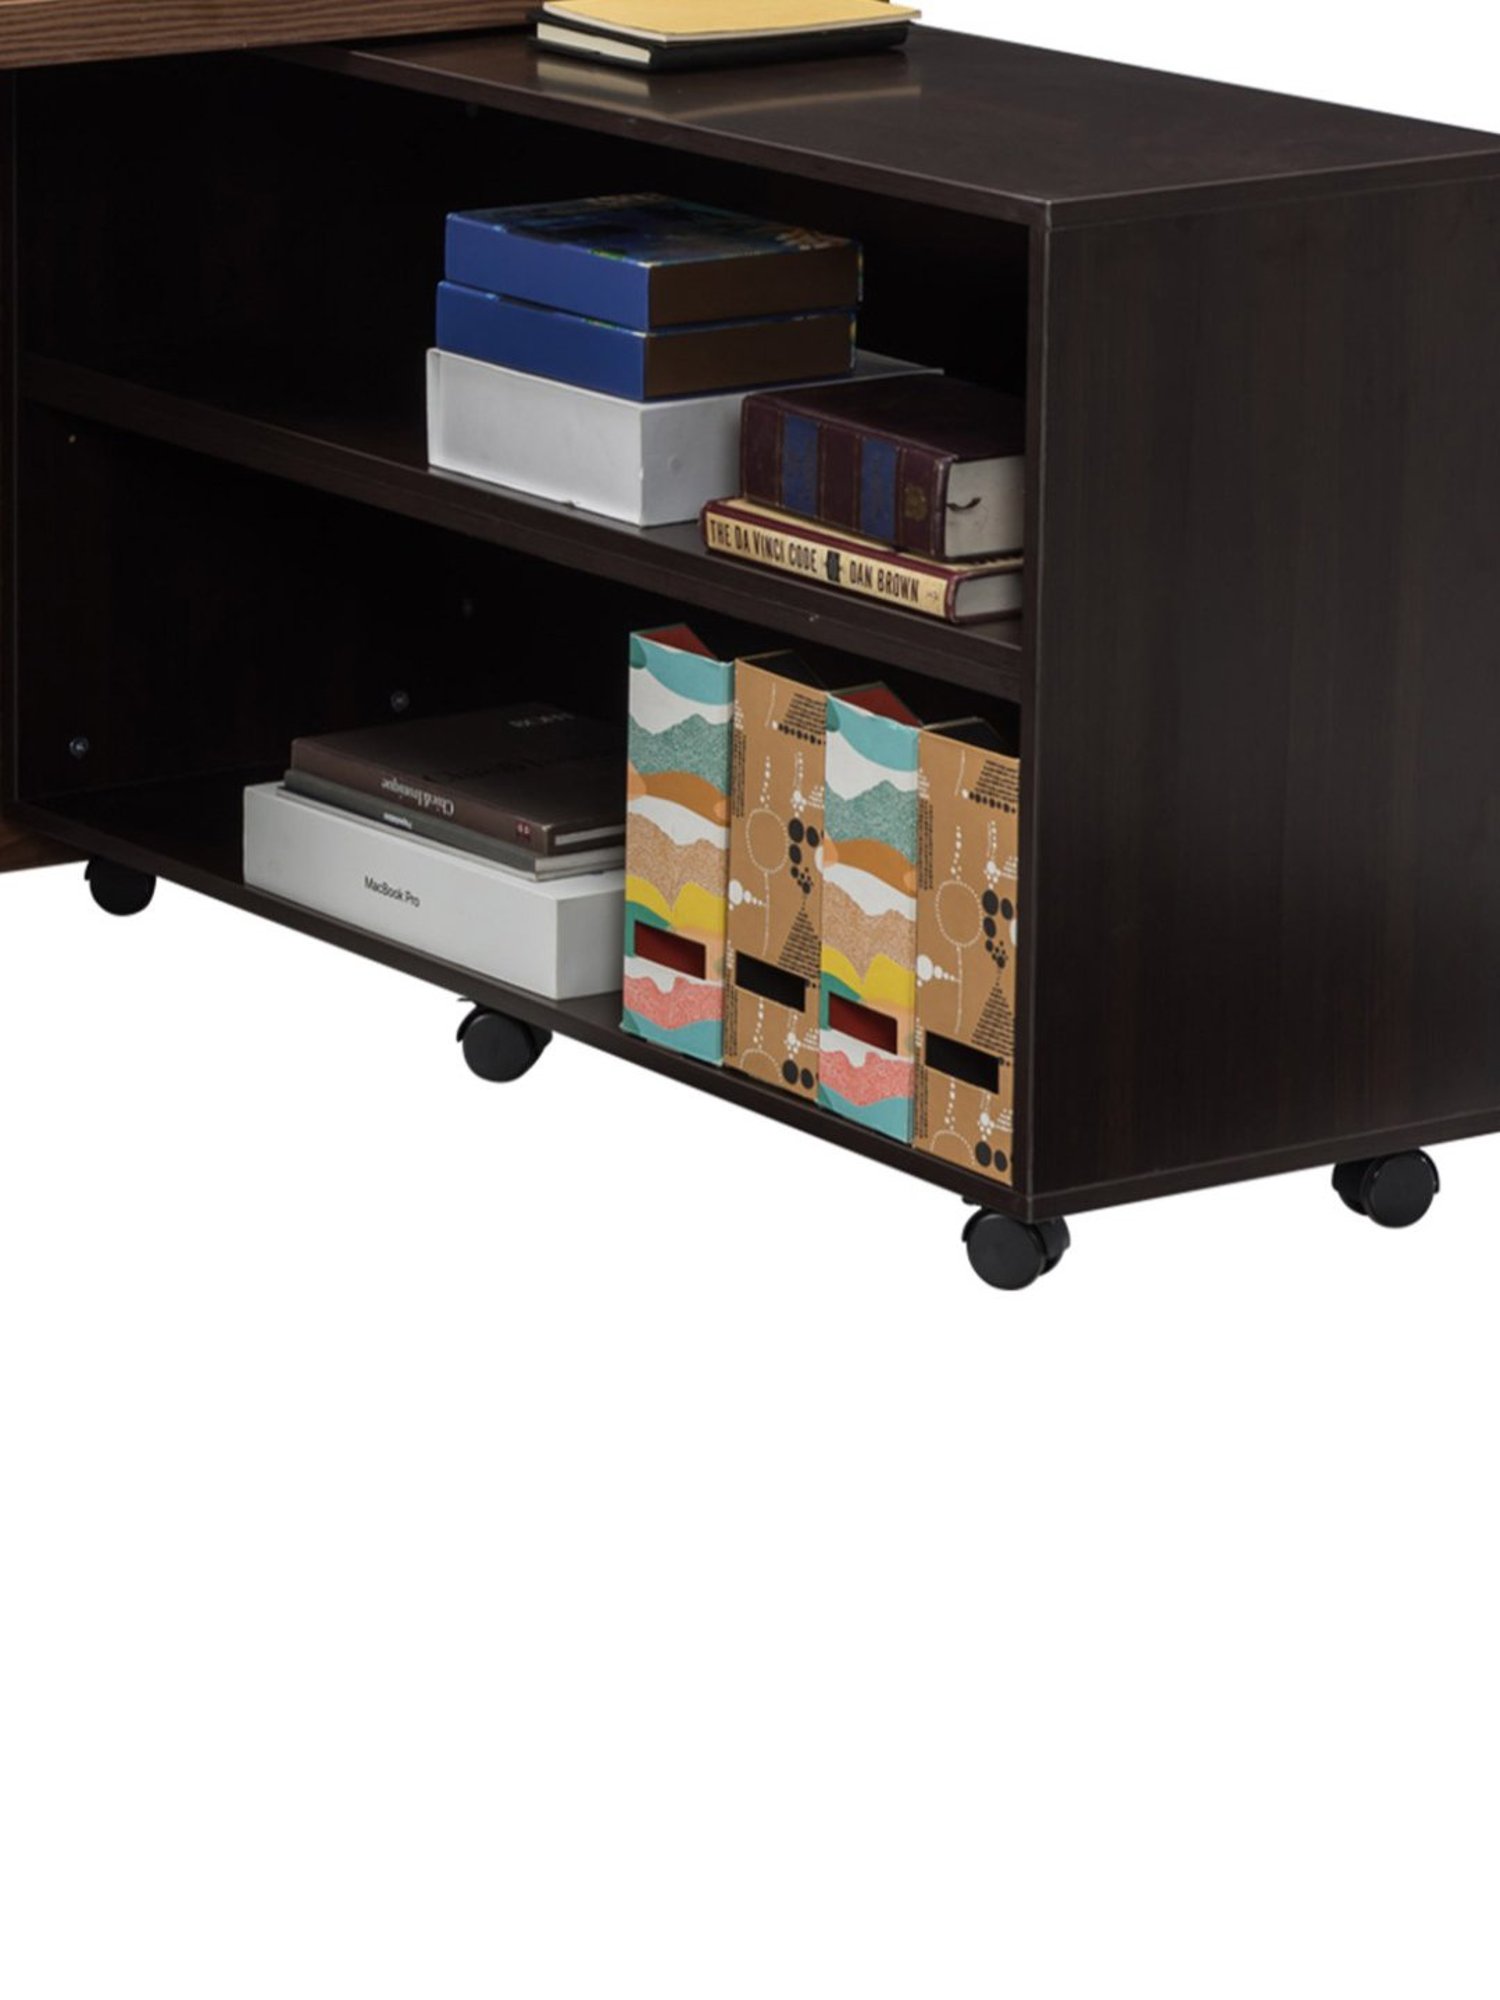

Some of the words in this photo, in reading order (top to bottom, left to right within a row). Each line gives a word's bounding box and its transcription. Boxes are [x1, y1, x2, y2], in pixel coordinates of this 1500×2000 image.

[710, 519, 731, 547] THE
[734, 525, 751, 553] DA
[752, 530, 785, 563] VINCI
[788, 541, 817, 573] CODE
[849, 560, 873, 589] DAN
[877, 567, 919, 603] BROWN
[364, 874, 403, 901] MacBook
[403, 889, 420, 908] Pro
